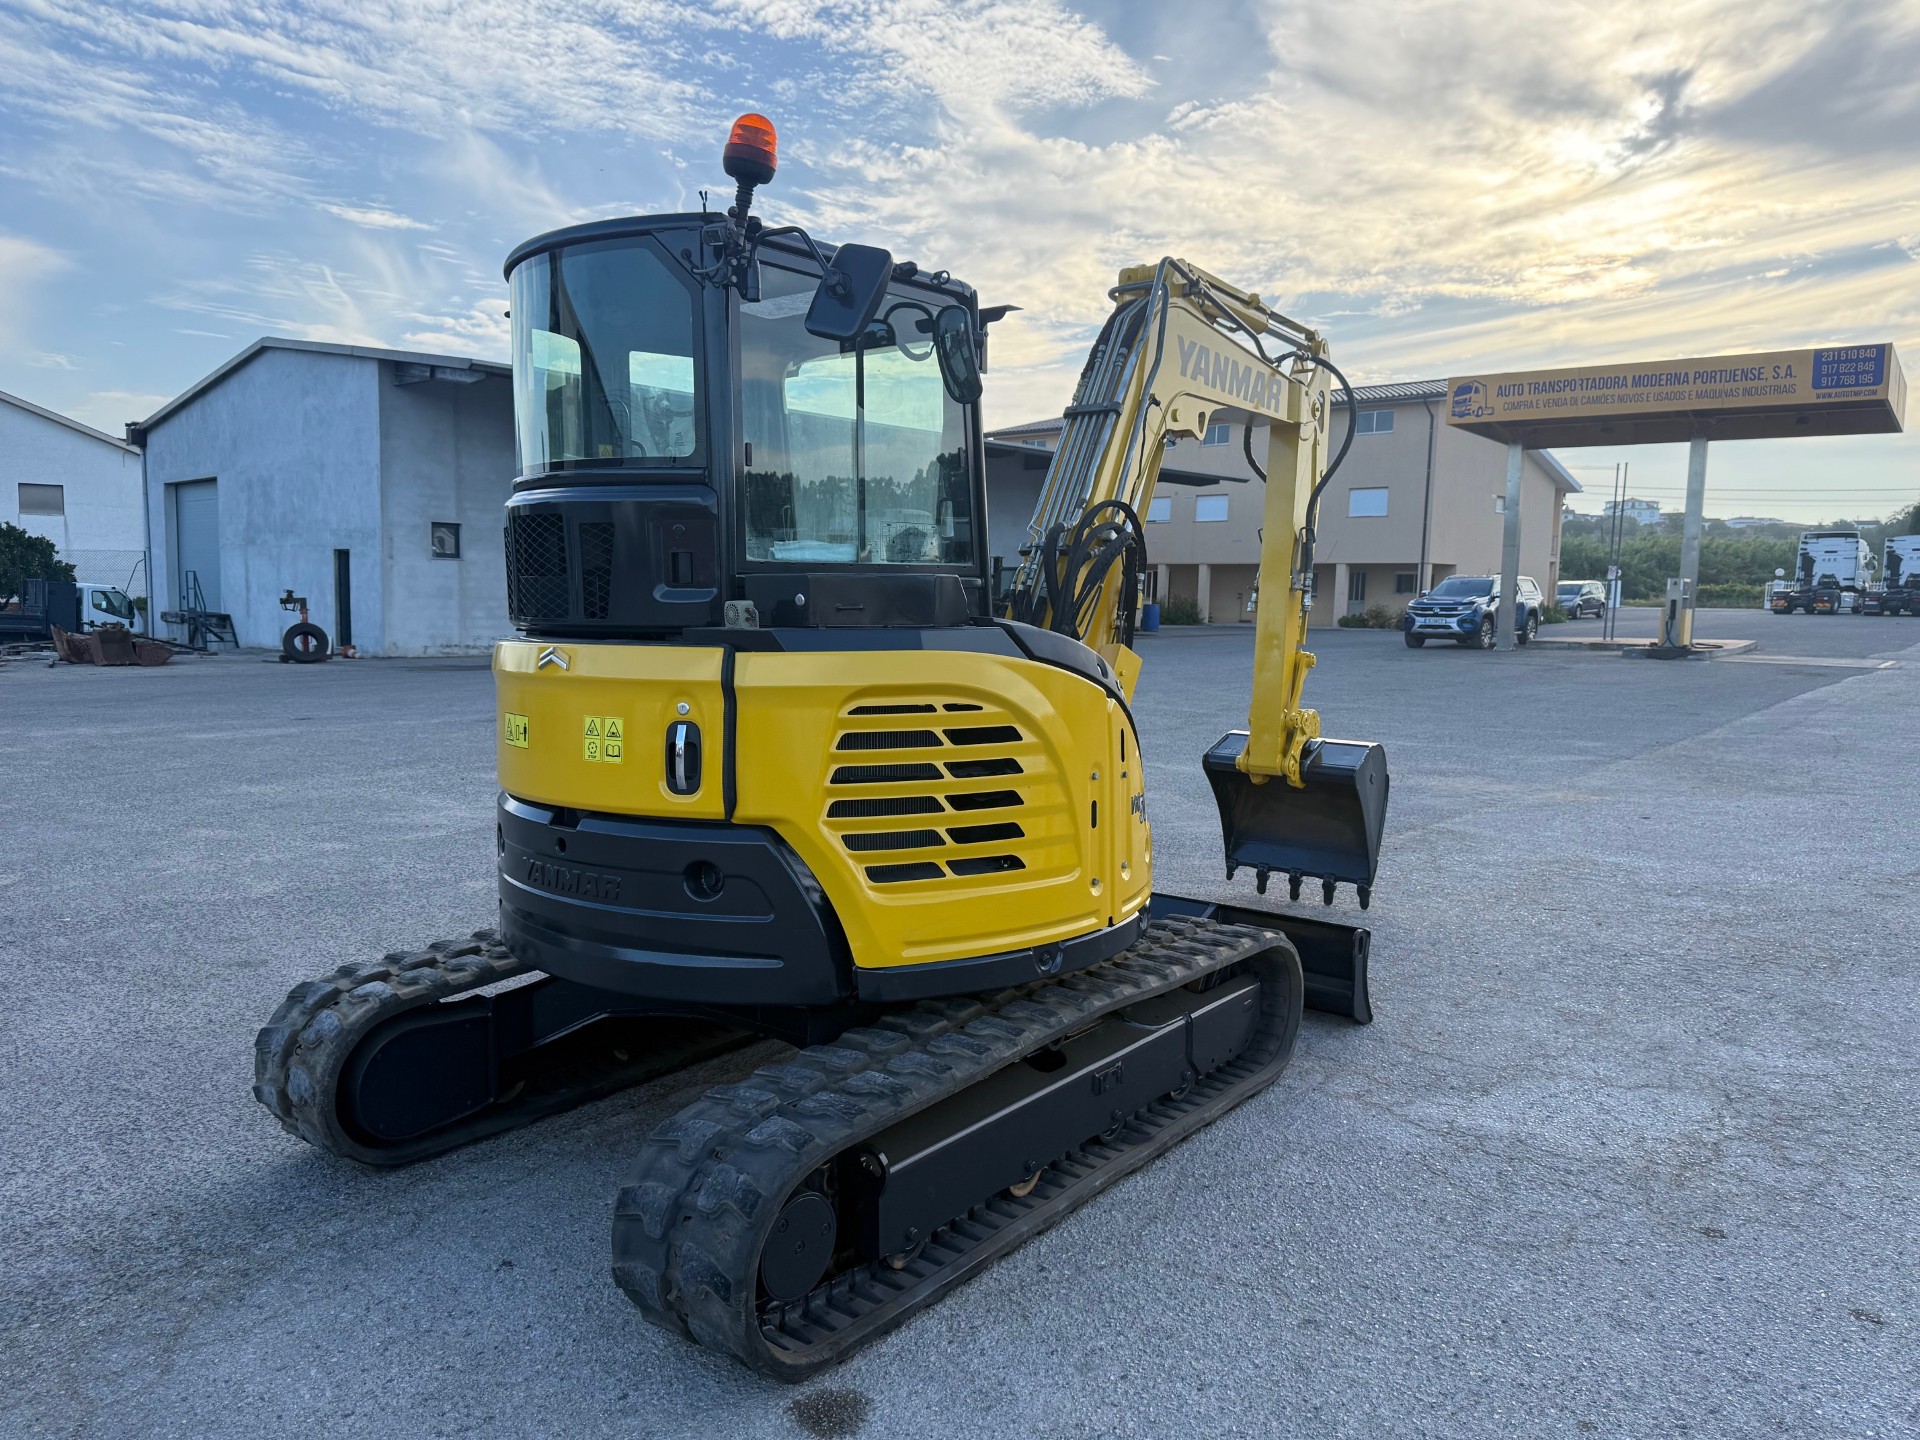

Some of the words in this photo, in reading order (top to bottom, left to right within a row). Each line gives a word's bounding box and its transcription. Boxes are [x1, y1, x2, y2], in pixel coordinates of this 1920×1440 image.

[1821, 363, 1837, 374] 917
[1839, 362, 1856, 372] 822
[1857, 361, 1875, 371] 846
[1822, 351, 1838, 361] 231
[1840, 349, 1857, 360] 510
[1859, 348, 1876, 358] 840
[1177, 334, 1282, 414] YANMAR
[1496, 383, 1524, 398] AUTO
[1527, 375, 1628, 396] TRANSPORTADORA
[1631, 371, 1690, 389] MODERNA
[1693, 366, 1768, 385] PORTUENSE,
[1772, 364, 1797, 379] S.A.
[1821, 376, 1837, 386] 917
[1839, 375, 1856, 385] 768
[1858, 373, 1874, 383] 195
[1503, 400, 1534, 411] COMPRA
[1536, 399, 1541, 409] E
[1543, 397, 1568, 408] VENDA
[1617, 393, 1645, 404] NOVOS
[1646, 392, 1651, 402] E
[1653, 390, 1686, 402] USADOS
[1688, 390, 1694, 400] E
[1742, 383, 1797, 396] INDUSTRIAIS
[522, 856, 621, 900] YANMAR
